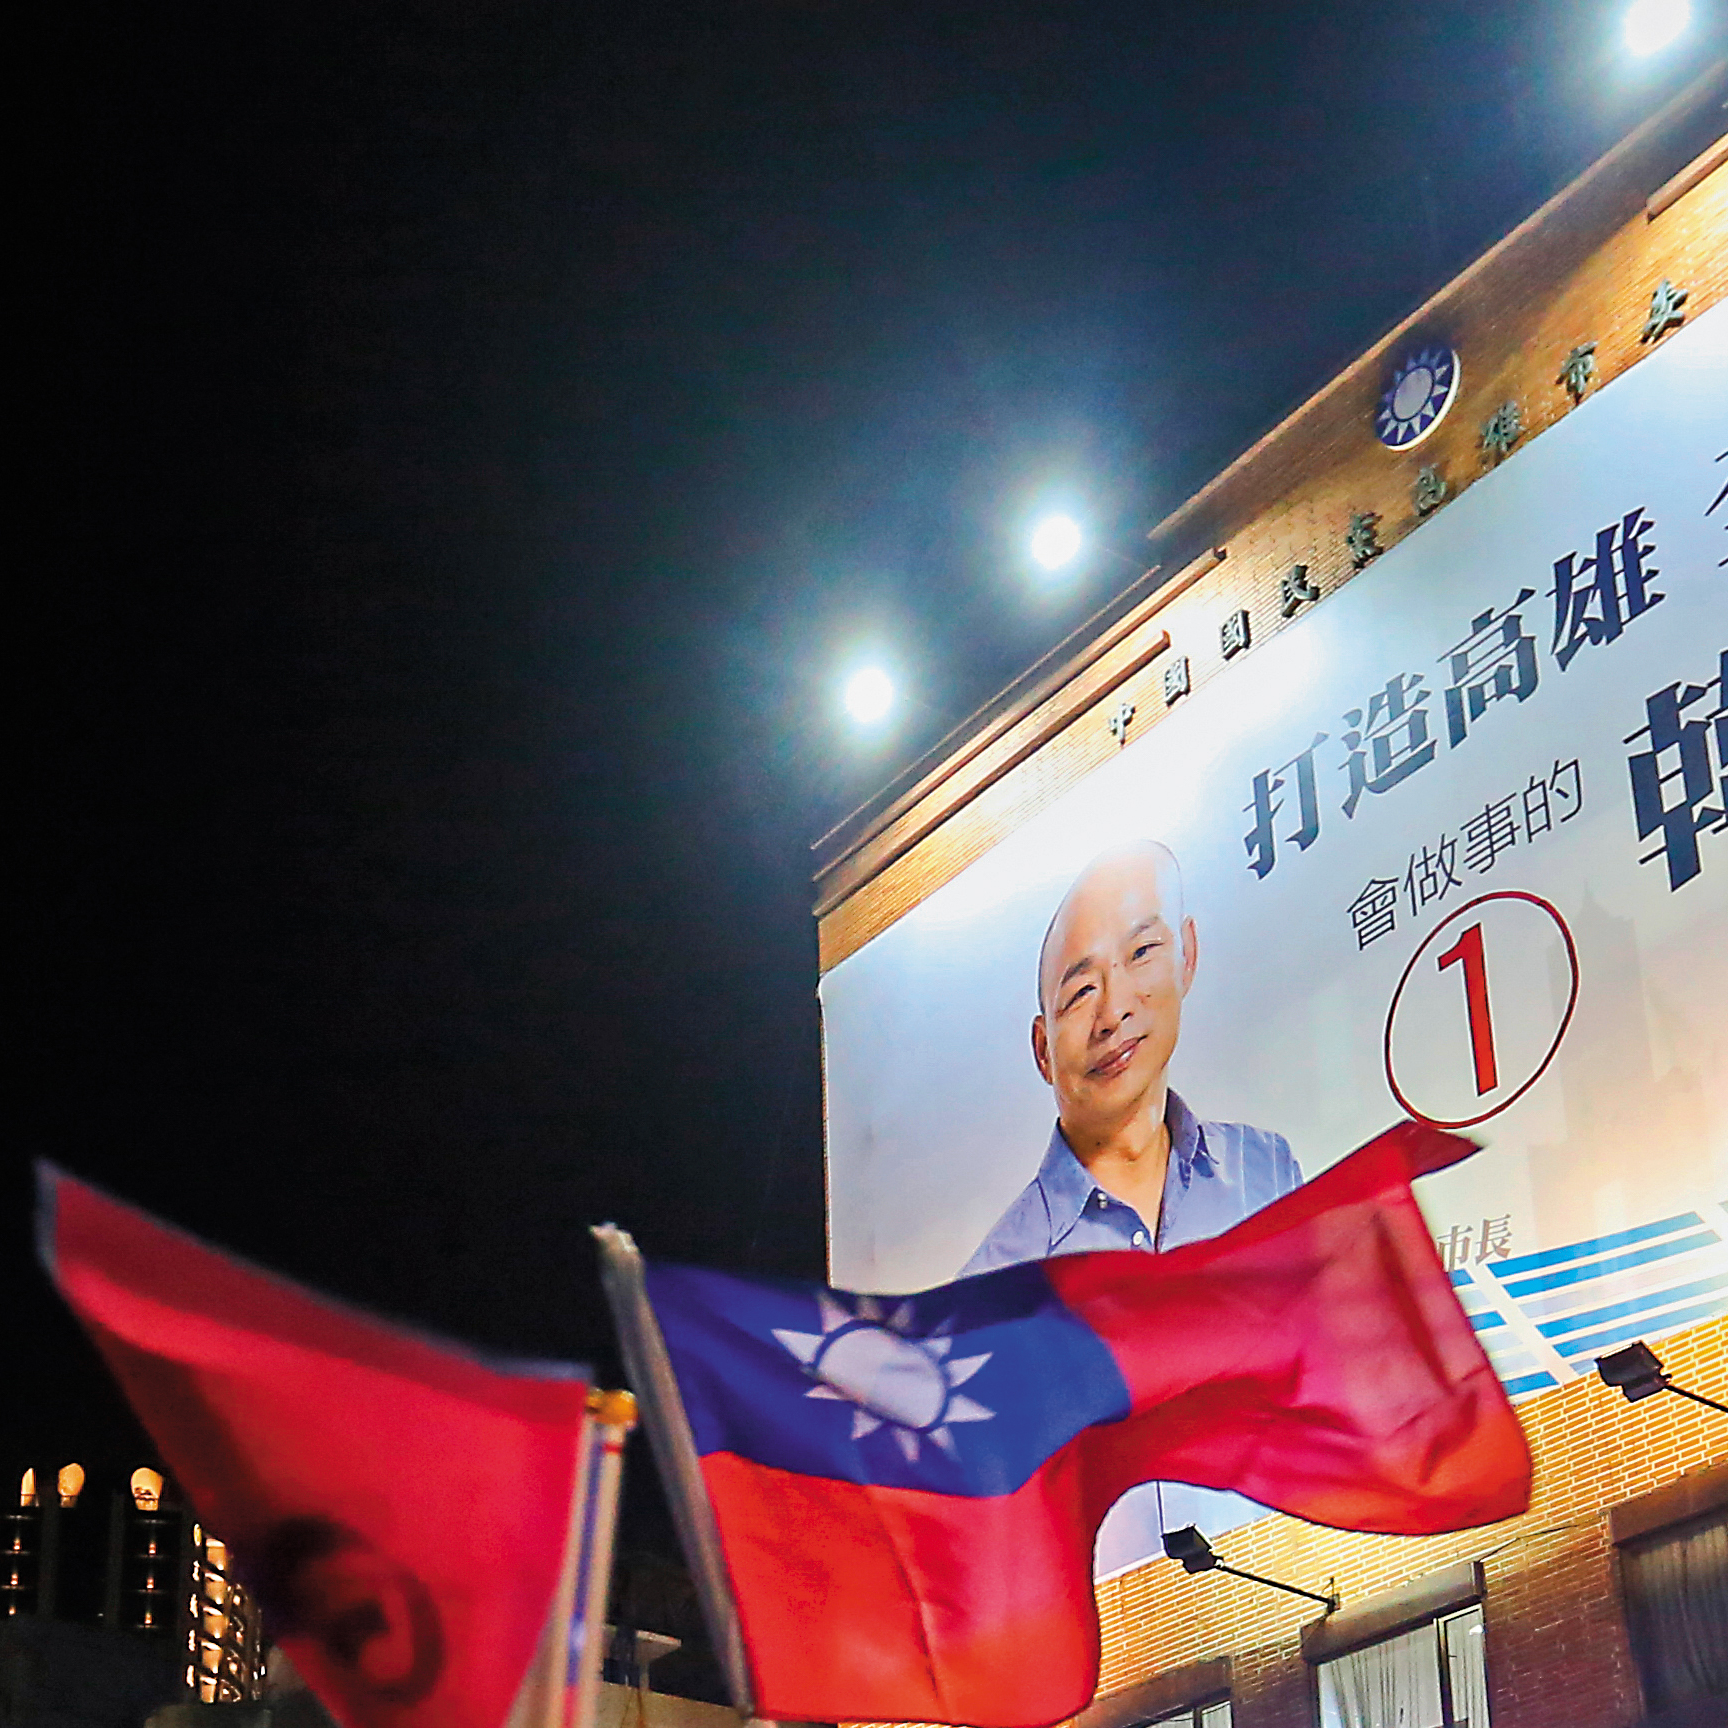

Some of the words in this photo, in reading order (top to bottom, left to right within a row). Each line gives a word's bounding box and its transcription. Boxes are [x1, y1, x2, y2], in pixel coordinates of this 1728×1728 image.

[1241, 507, 1666, 881] 打造高雄
[1345, 756, 1584, 951] 會做事的
[1437, 922, 1499, 1097] 1
